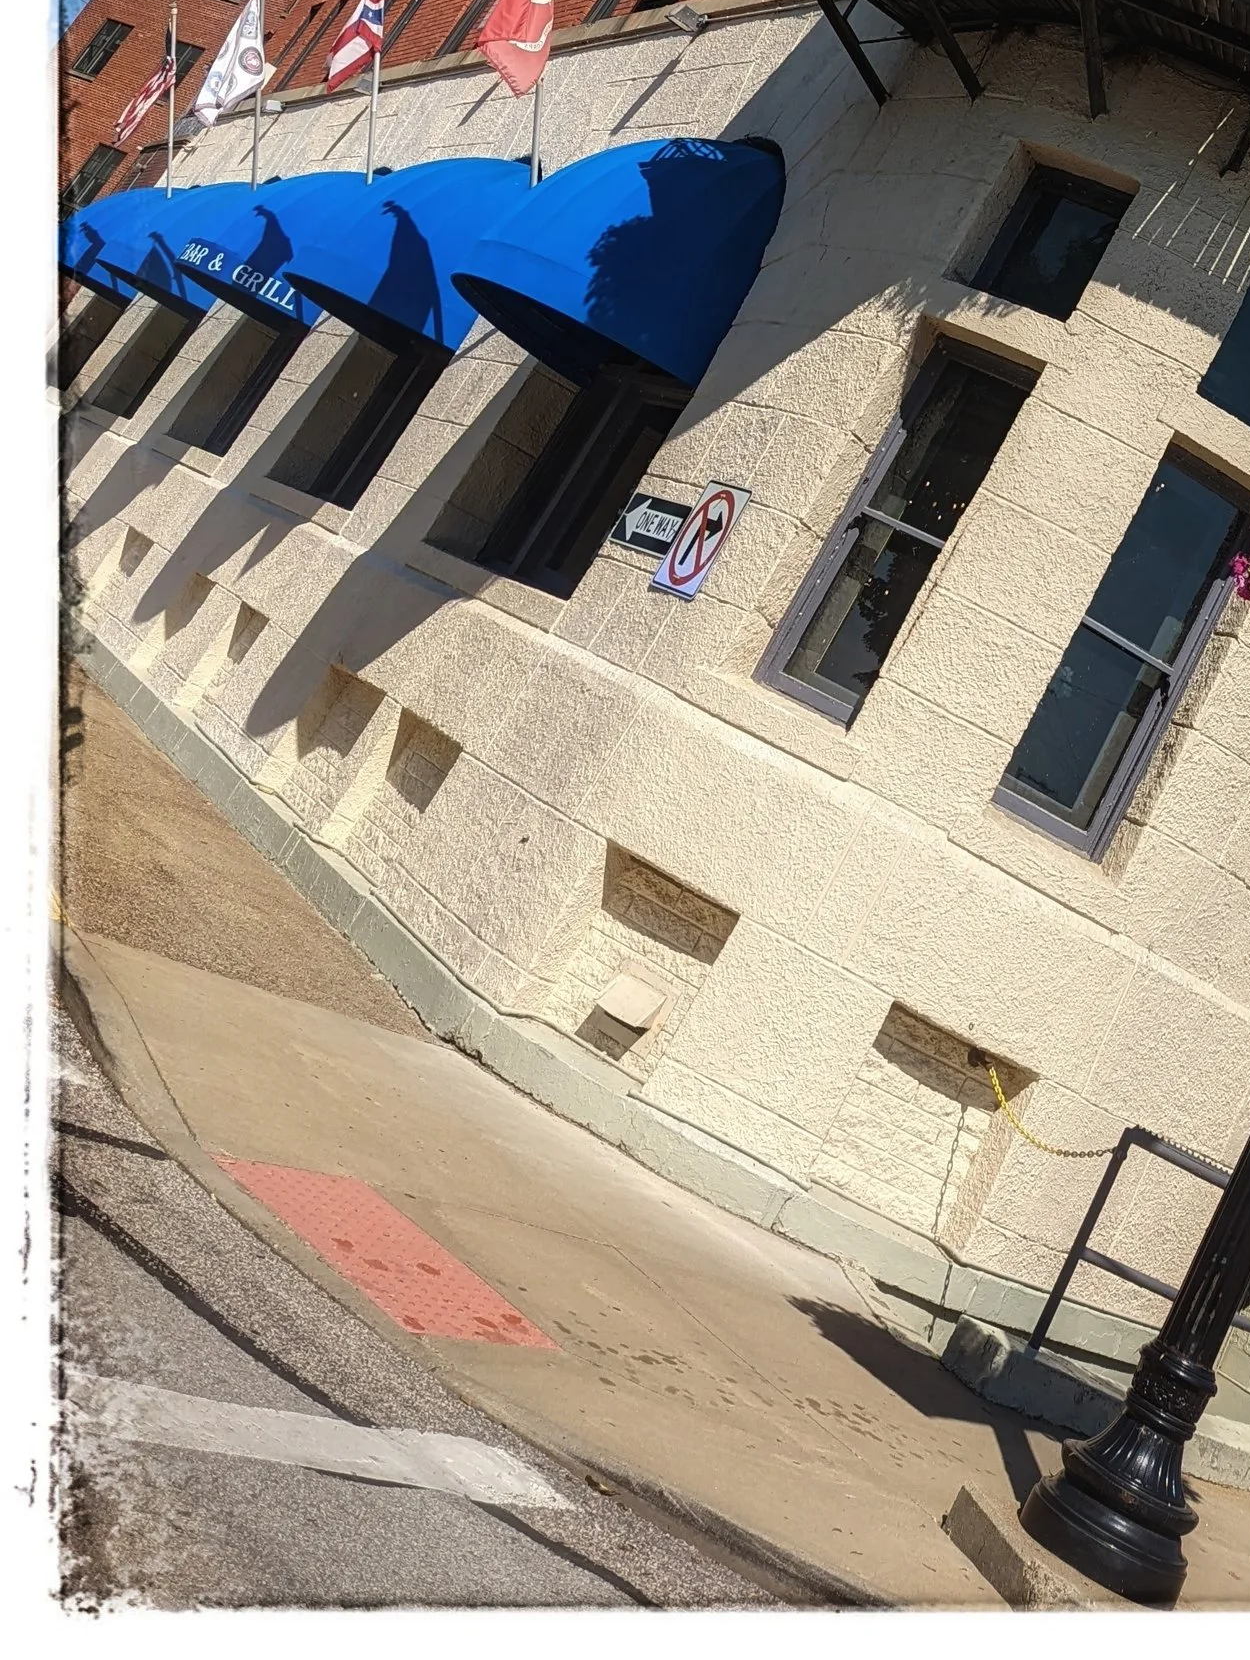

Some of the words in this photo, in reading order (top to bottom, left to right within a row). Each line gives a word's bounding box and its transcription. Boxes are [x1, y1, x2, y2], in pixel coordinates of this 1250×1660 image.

[180, 243, 209, 265] BAR
[208, 253, 224, 271] &
[232, 264, 296, 311] GRILL
[635, 511, 659, 532] ONE
[652, 516, 680, 538] WAY
